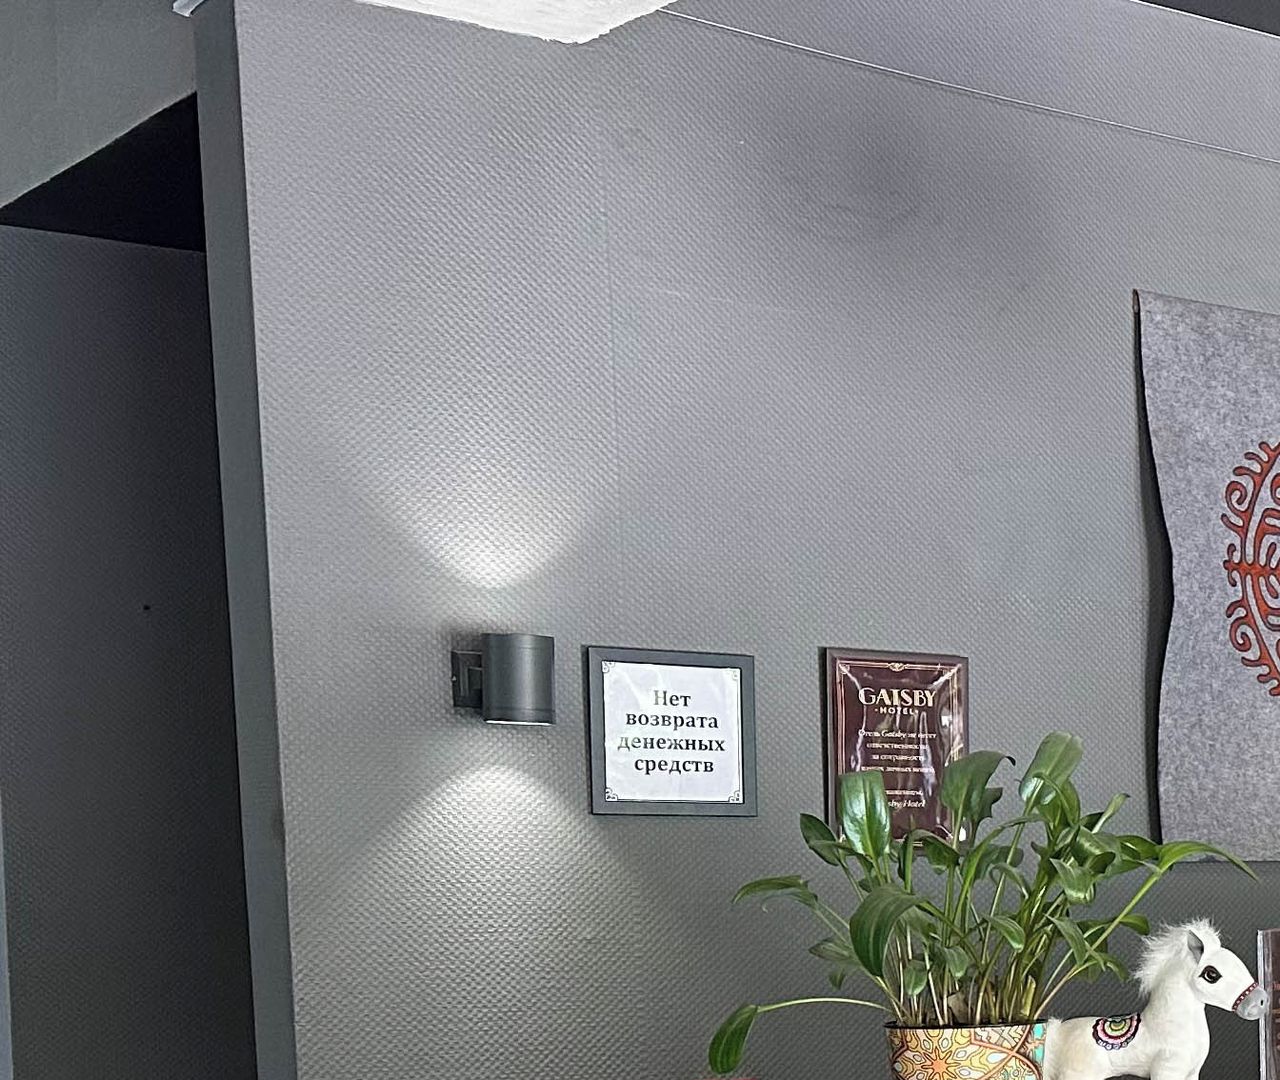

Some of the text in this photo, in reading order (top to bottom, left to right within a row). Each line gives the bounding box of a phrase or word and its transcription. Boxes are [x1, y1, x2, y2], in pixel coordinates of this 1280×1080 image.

[653, 690, 691, 707] Нет
[858, 687, 936, 707] GATSBY
[625, 713, 719, 731] возврата
[617, 736, 725, 752] денежных
[634, 759, 714, 775] средств
